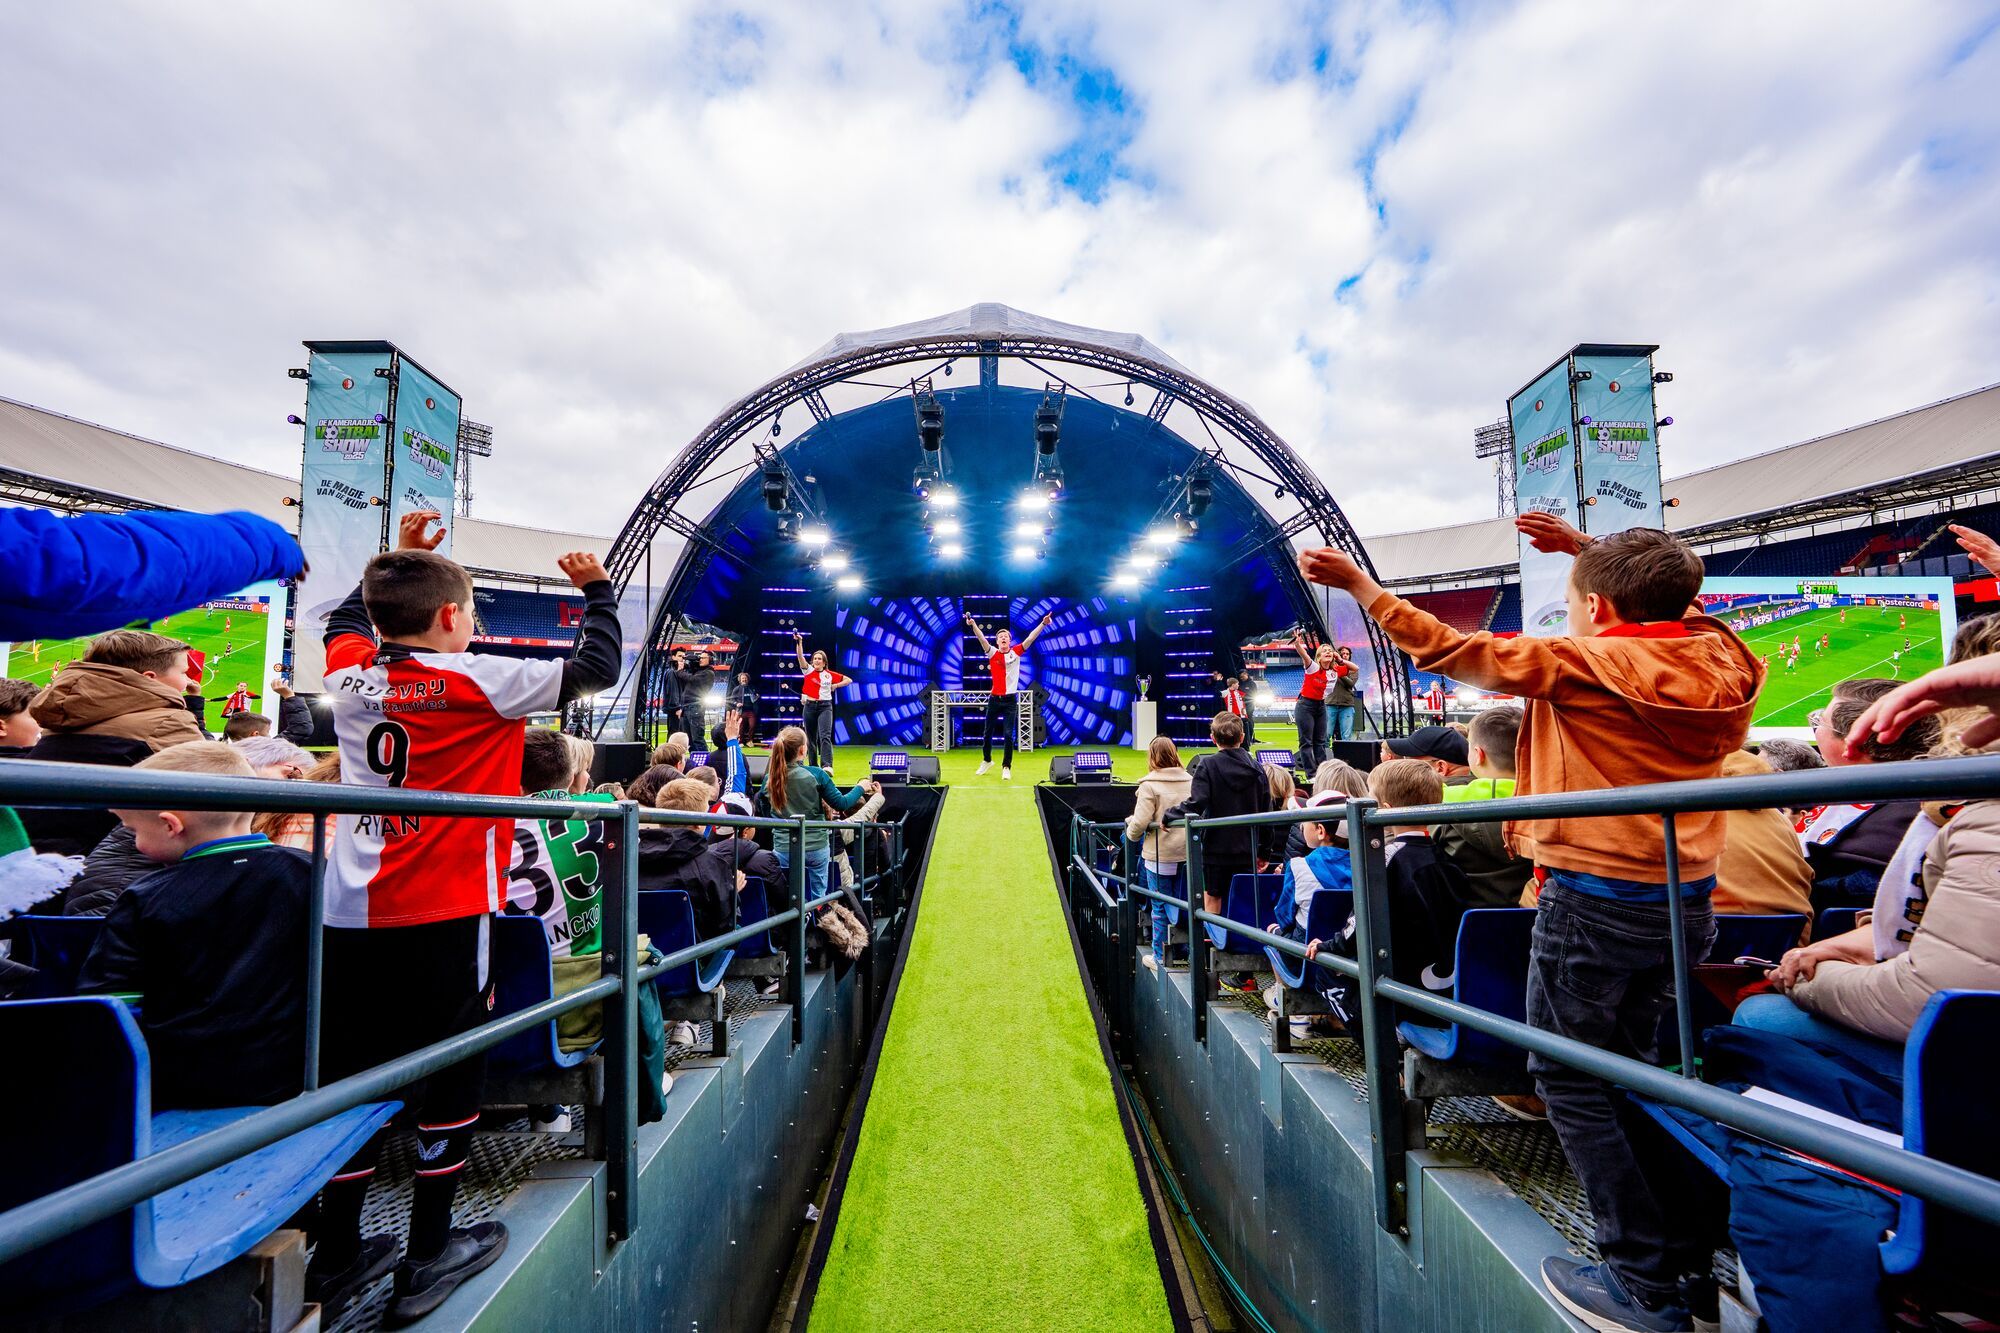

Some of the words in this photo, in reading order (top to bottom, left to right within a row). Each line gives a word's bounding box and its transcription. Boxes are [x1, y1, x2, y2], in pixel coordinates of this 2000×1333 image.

[315, 425, 380, 439] VOETBAL
[1587, 427, 1650, 441] VOETBAL
[322, 438, 371, 454] SHOW
[1597, 440, 1642, 456] SHOW
[343, 451, 365, 460] 2025
[409, 448, 446, 474] SHOW
[1526, 448, 1562, 475] SHOW
[1618, 453, 1638, 461] 2025
[333, 481, 366, 499] MAGIE
[408, 487, 418, 496] DE
[1611, 481, 1643, 500] MAGIE
[317, 488, 336, 496] VAN
[335, 492, 346, 500] DE
[343, 497, 369, 510] KUIP
[1614, 492, 1625, 500] DE
[1623, 497, 1648, 510] KUIP
[1796, 585, 1839, 594] VOETBAL
[1802, 594, 1834, 604] SHOW
[1752, 612, 1773, 627] PEPSI
[363, 699, 448, 713] vakanties
[367, 720, 410, 788] 9
[353, 815, 421, 837] RYAN
